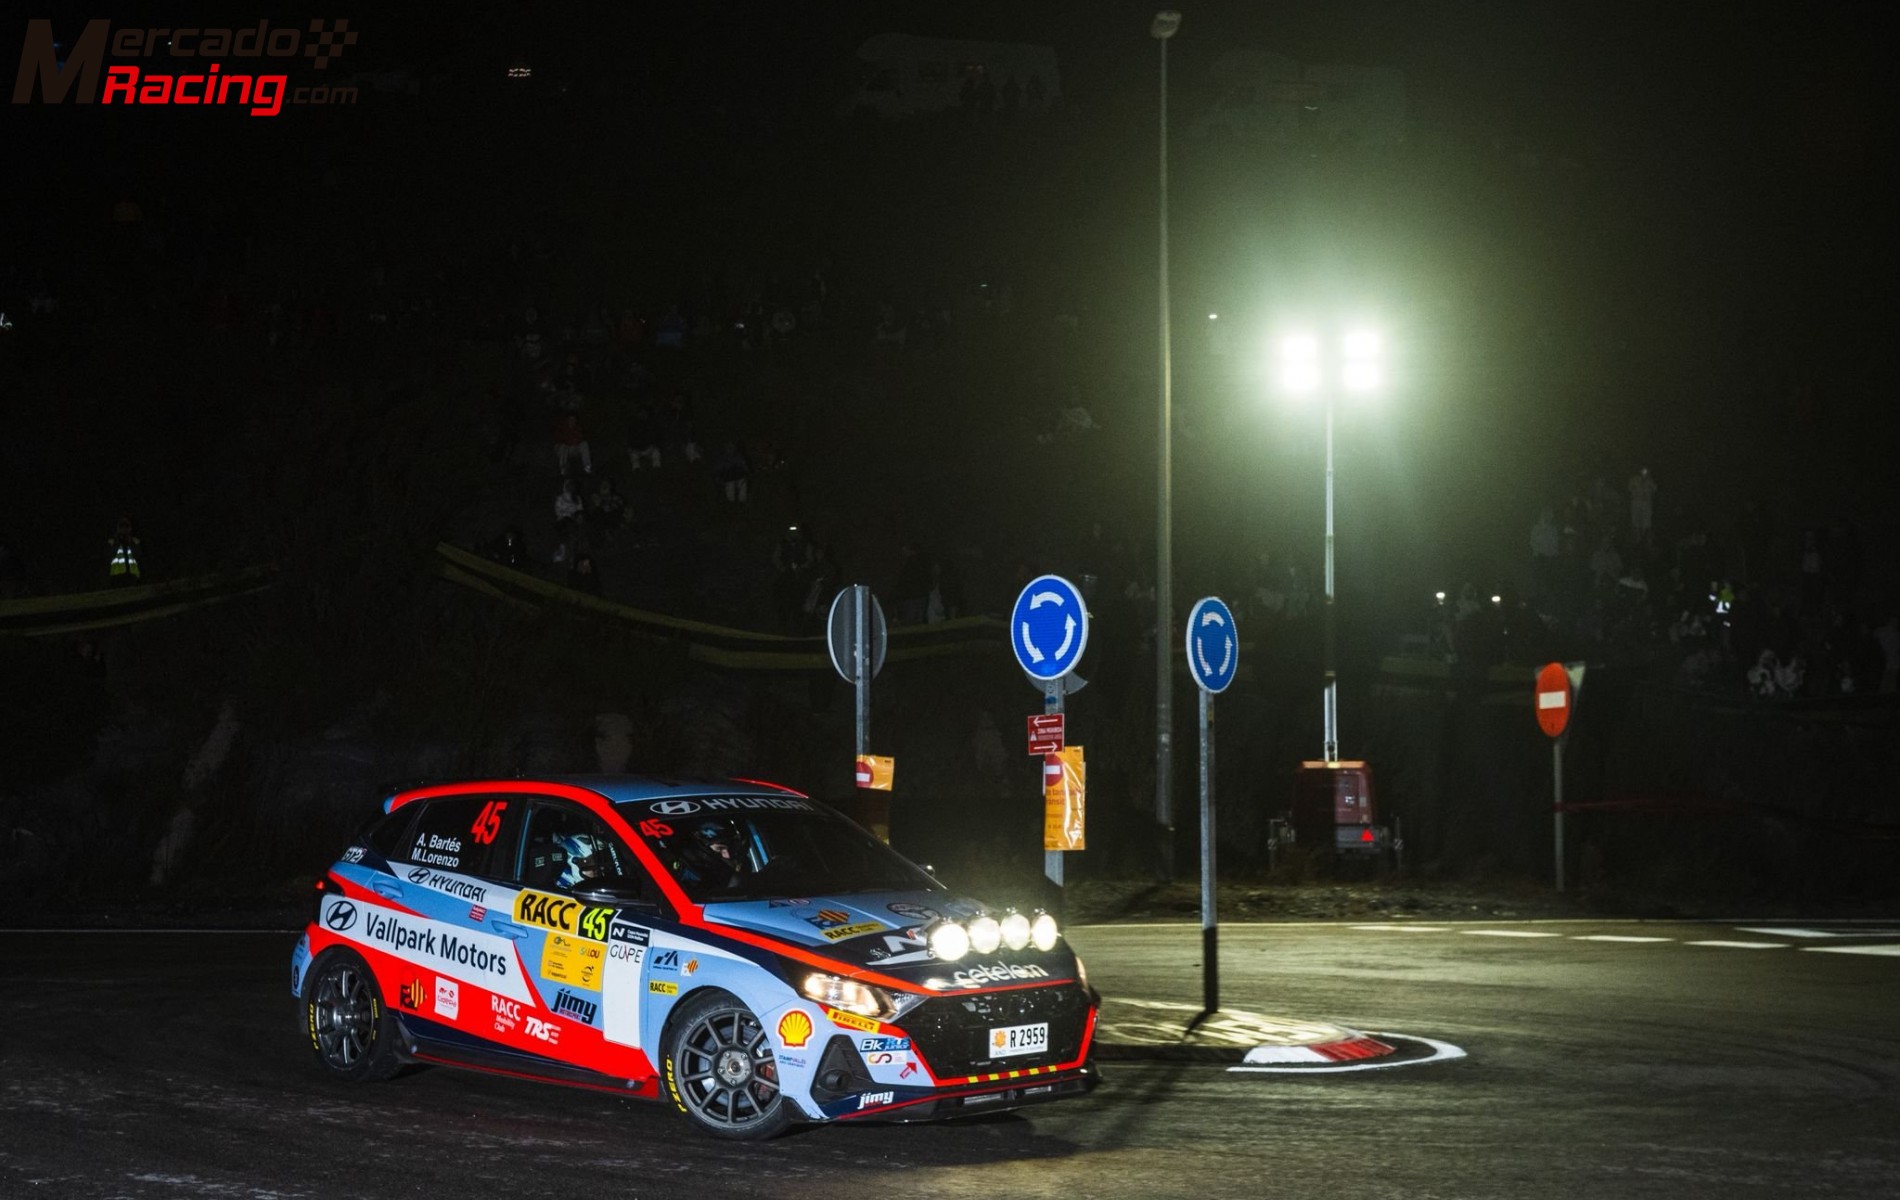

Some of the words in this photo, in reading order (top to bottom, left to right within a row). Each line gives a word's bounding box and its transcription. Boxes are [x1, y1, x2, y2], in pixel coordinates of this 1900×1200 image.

[700, 798, 814, 811] HYUNDAI
[470, 801, 508, 845] 45
[638, 818, 675, 840] 45
[416, 832, 427, 847] A.
[428, 834, 462, 852] Bartés
[411, 847, 460, 868] M.Lorenzo
[428, 873, 487, 903] HYUNDAI
[520, 894, 578, 930] RACC
[582, 908, 617, 940] 45
[824, 926, 860, 940] RACC
[366, 911, 436, 955] Vallpark
[440, 936, 507, 975] Motors
[650, 982, 666, 993] RACC
[491, 994, 521, 1021] RACC
[551, 988, 598, 1025] jimy
[832, 1011, 875, 1031] PIRELLI
[861, 1038, 885, 1051] Bk
[1009, 1029, 1017, 1048] R
[1019, 1026, 1046, 1047] 2959
[857, 1091, 894, 1110] jimy
